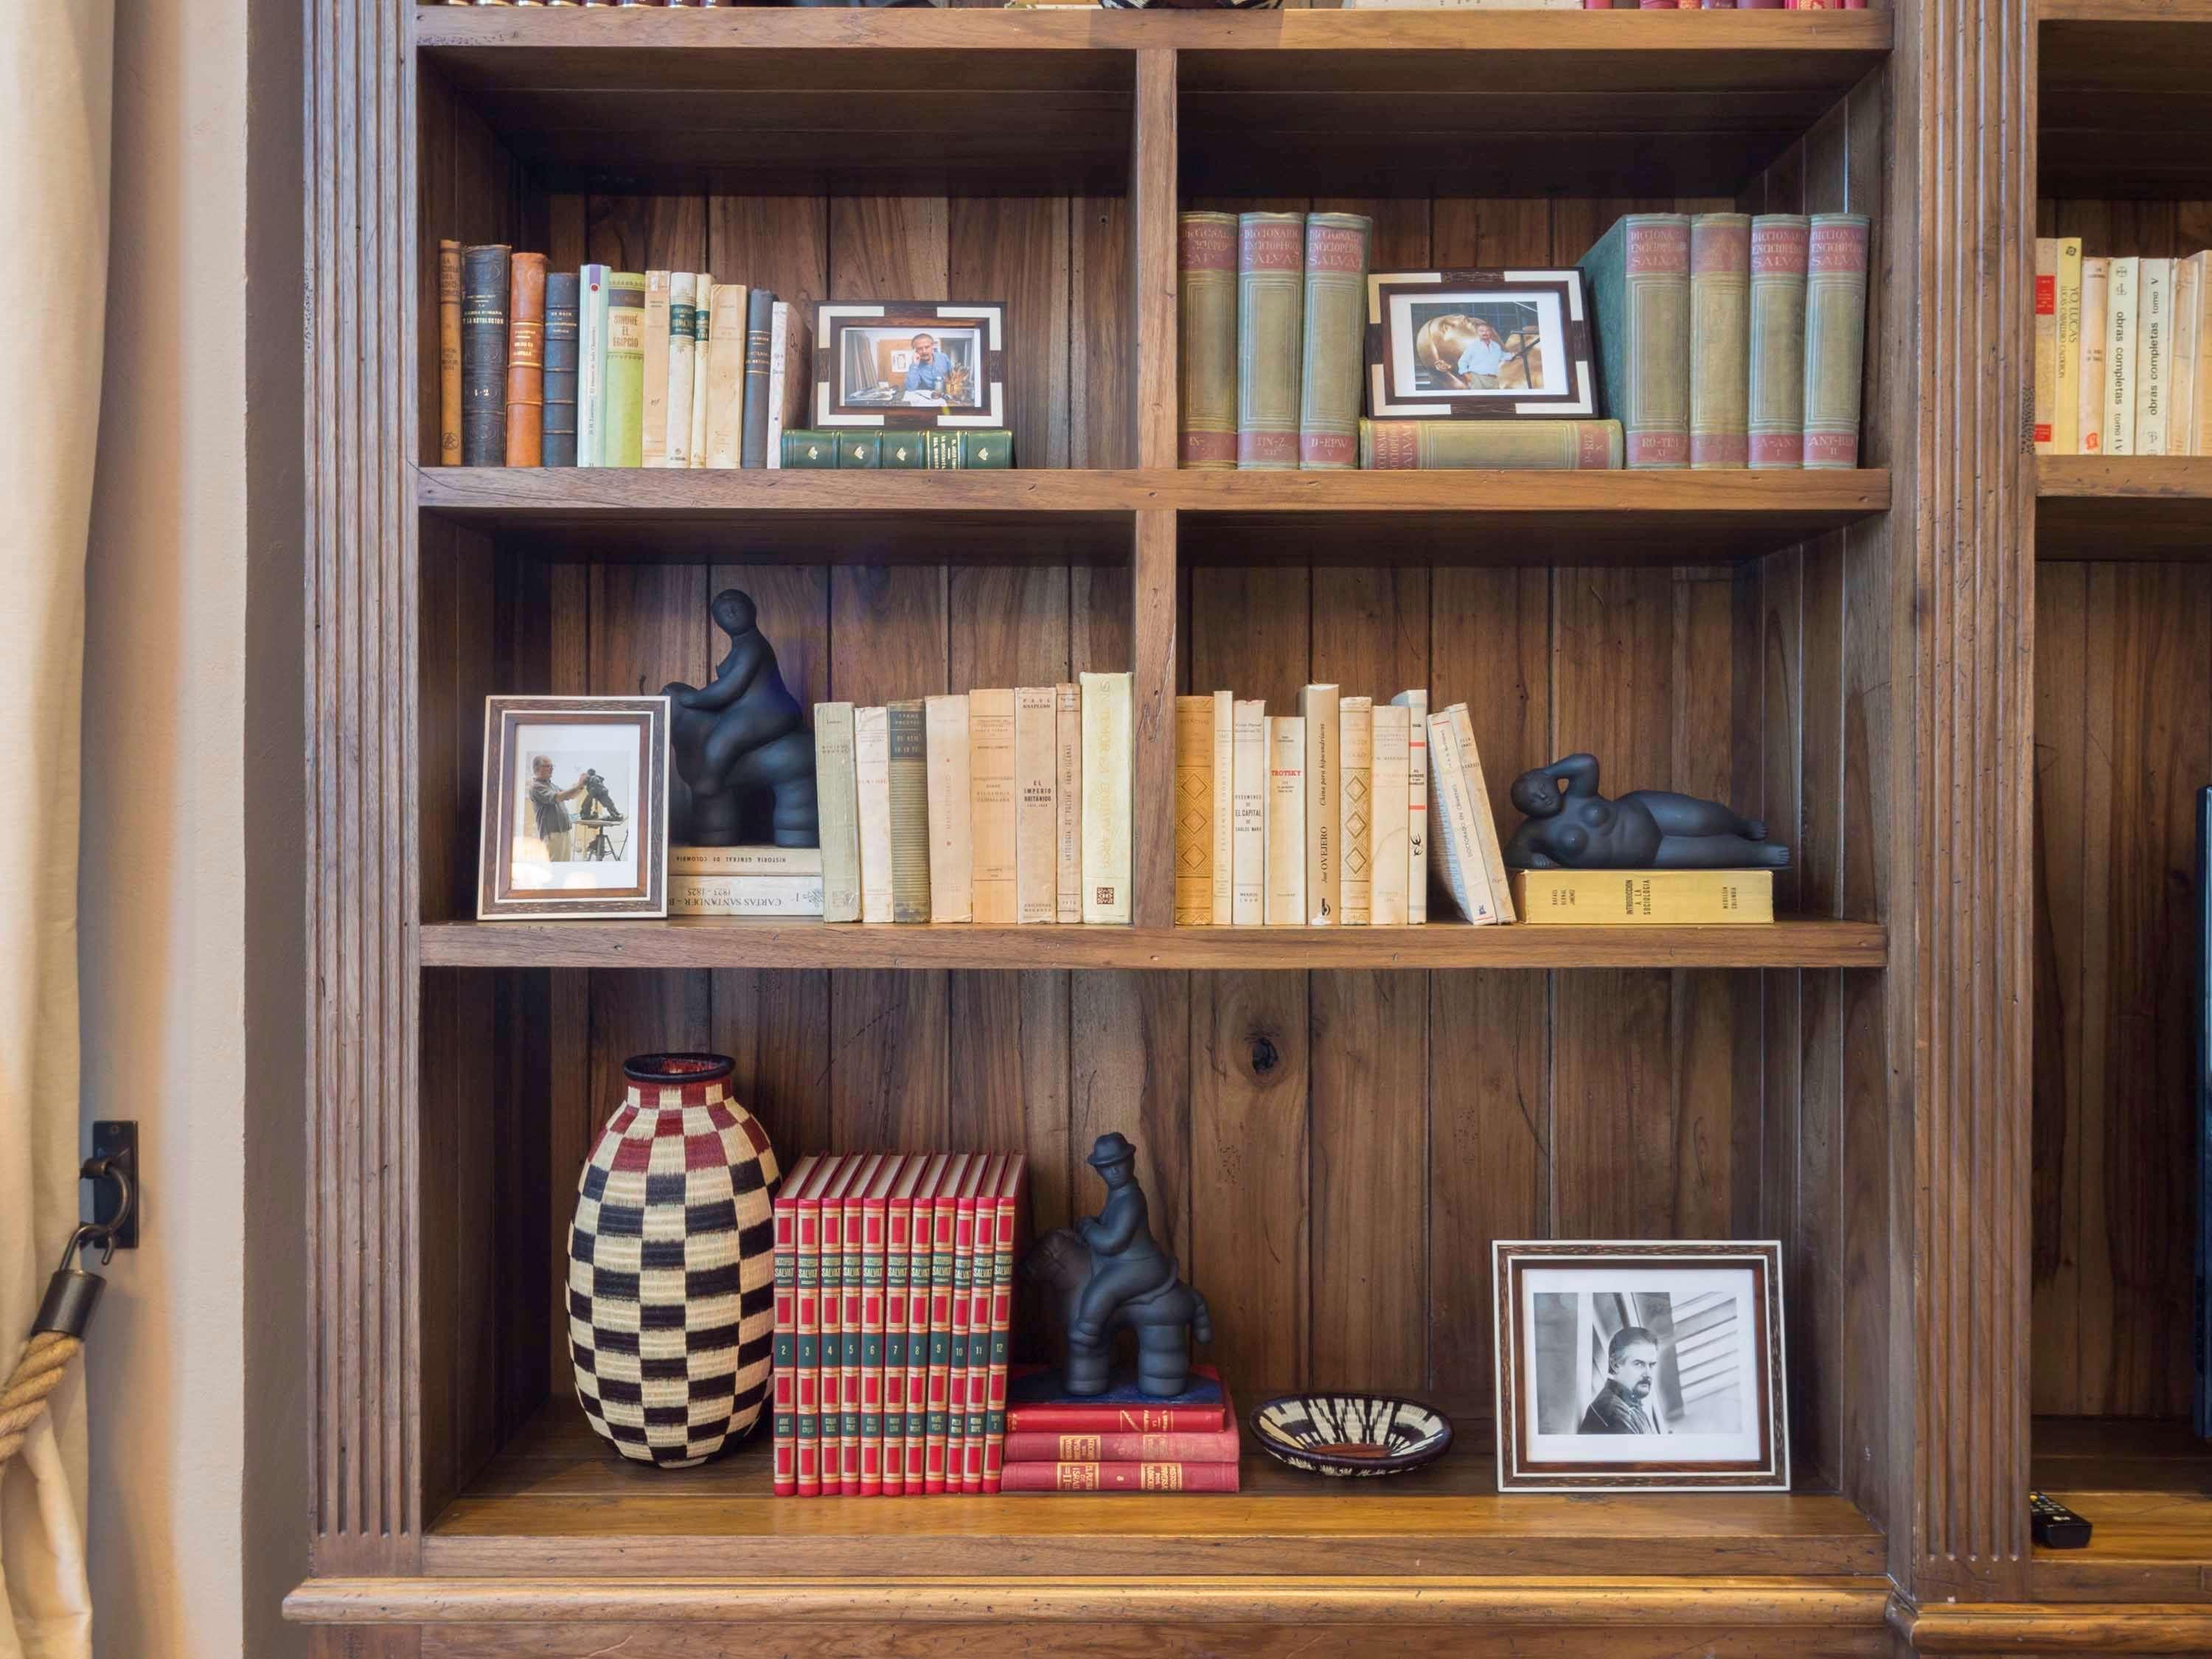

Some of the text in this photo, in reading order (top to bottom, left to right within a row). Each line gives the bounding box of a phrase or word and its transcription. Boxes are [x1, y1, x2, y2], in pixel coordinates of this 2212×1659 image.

[2067, 307, 2078, 343] LUCAS
[2115, 311, 2125, 342] obras
[2148, 277, 2160, 416] obras completas tomo V
[2113, 347, 2125, 405] completas
[2114, 413, 2122, 436] tomo
[1318, 787, 1326, 806] China
[1235, 809, 1262, 817] EL CAPITAL
[1634, 888, 1641, 897] LA
[1642, 879, 1651, 915] SOCIOLOGIA
[684, 897, 743, 906] SANTANDER
[745, 897, 782, 906] CARTAS
[774, 1267, 794, 1277] SALVAT
[799, 1268, 818, 1278] SALVAT
[821, 1267, 841, 1277] SALVAT
[863, 1267, 883, 1277] SALVAT
[888, 1267, 907, 1277] SALVAT
[911, 1267, 930, 1277] SALVAT
[932, 1266, 951, 1276] SALVAT
[973, 1267, 992, 1277] SALVAT
[995, 1265, 1012, 1275] SALVAT
[781, 1345, 786, 1355] 2
[805, 1346, 810, 1357] 3
[827, 1346, 832, 1355] 4
[849, 1344, 854, 1354] 5
[869, 1345, 875, 1355] 6
[893, 1345, 898, 1354] 7
[915, 1346, 919, 1355] 8
[936, 1343, 941, 1354] 9
[956, 1347, 963, 1357] 10
[975, 1346, 982, 1355] 11
[996, 1343, 1003, 1353] 12
